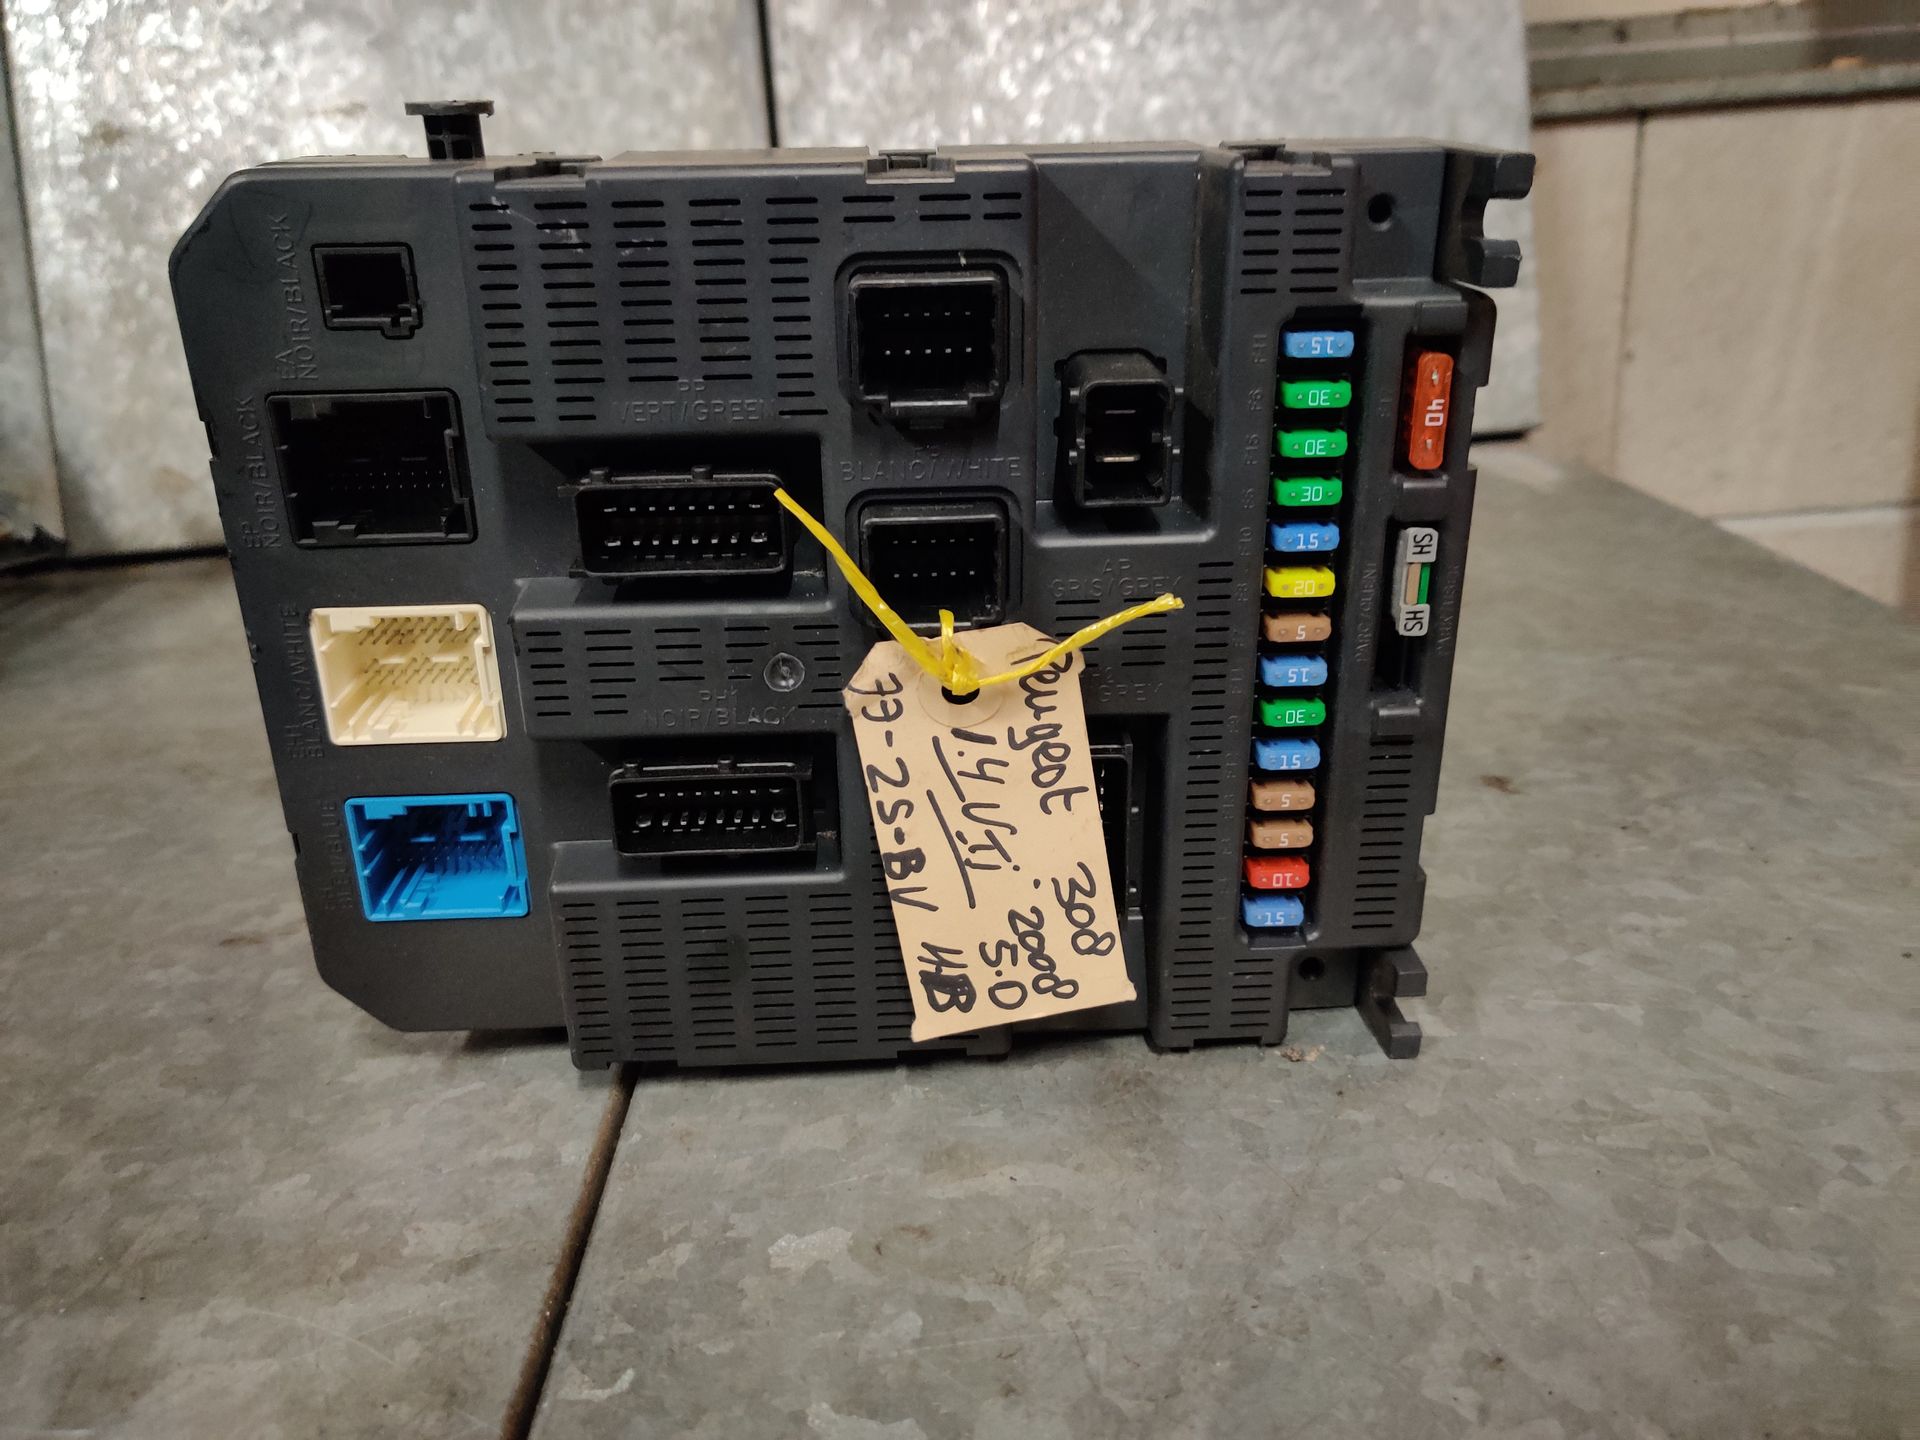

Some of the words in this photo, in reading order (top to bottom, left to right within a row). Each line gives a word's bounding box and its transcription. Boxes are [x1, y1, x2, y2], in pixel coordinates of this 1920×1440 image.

[1311, 336, 1334, 355] 15
[1308, 389, 1331, 406] 30
[1304, 438, 1327, 456] 30
[1300, 485, 1323, 502] 30
[1296, 532, 1319, 549] 15
[1293, 580, 1316, 595] 20
[1295, 625, 1306, 640] 5
[1288, 669, 1309, 683] 15
[1286, 709, 1306, 725] 30
[950, 727, 1009, 785] 1.4
[1280, 755, 1301, 769] 15
[1008, 637, 1089, 816] Peugeot
[1050, 861, 1116, 957] 308
[1281, 793, 1291, 808] 5
[1278, 832, 1289, 847] 5
[1272, 872, 1293, 887] 10
[1264, 911, 1285, 925] 15
[1008, 905, 1079, 1000] 2008
